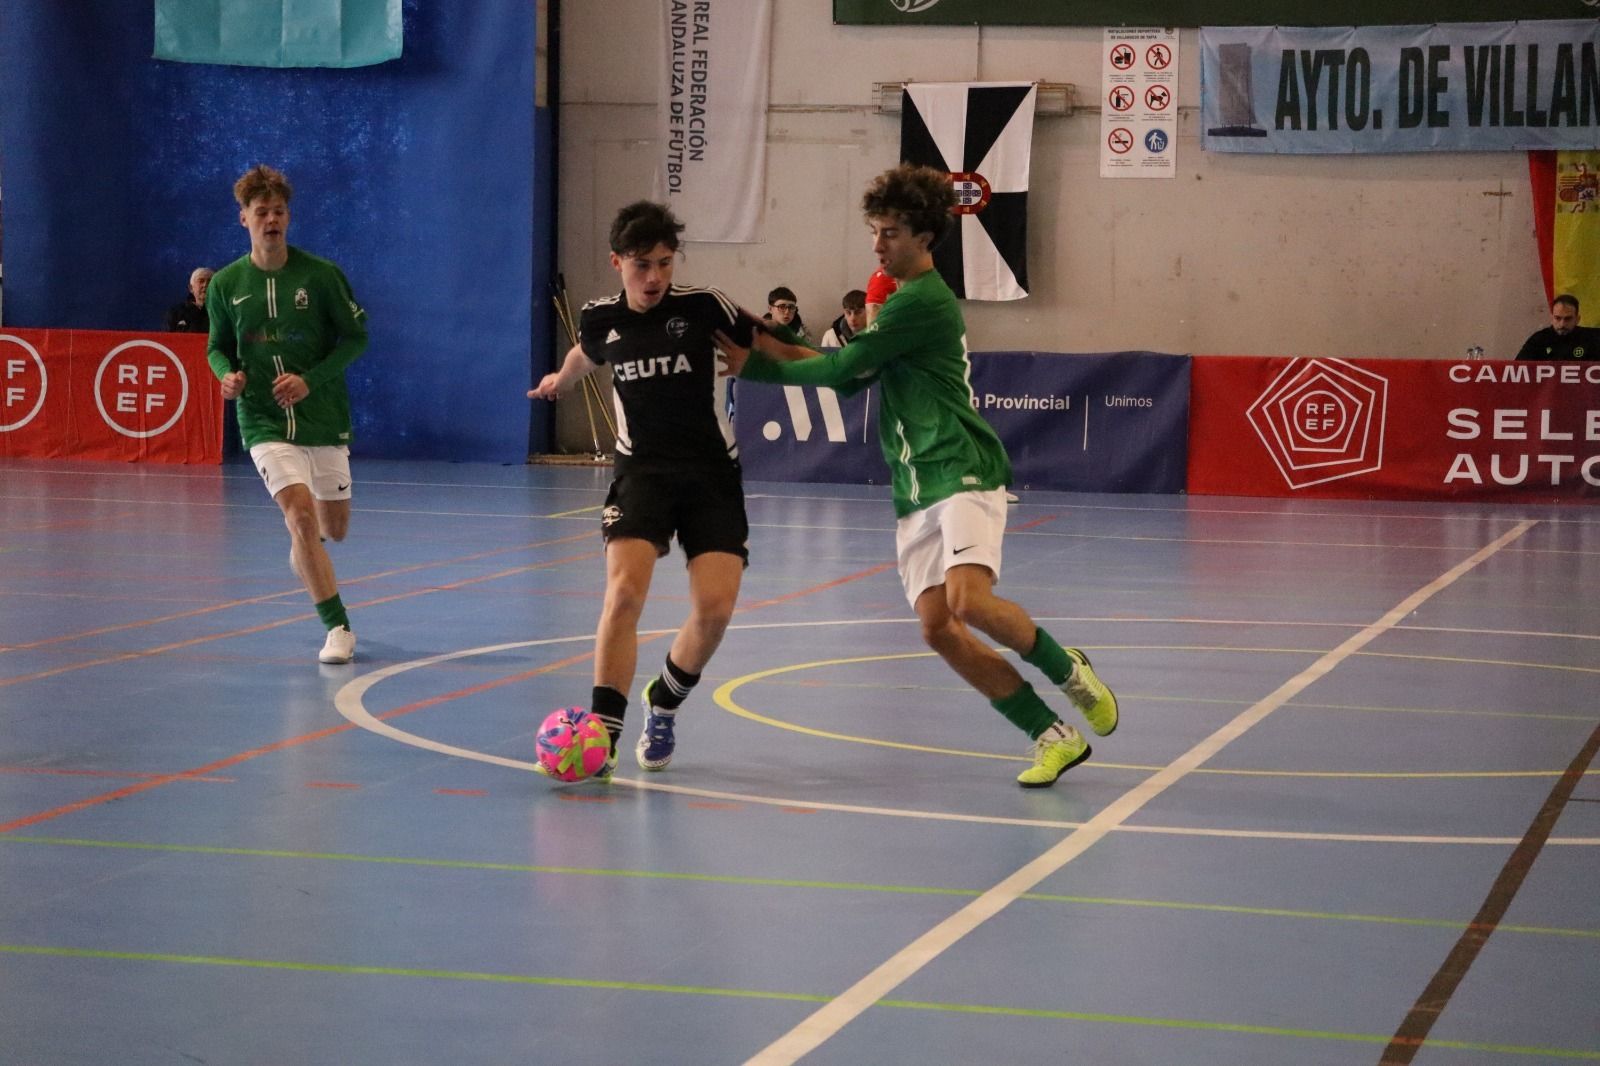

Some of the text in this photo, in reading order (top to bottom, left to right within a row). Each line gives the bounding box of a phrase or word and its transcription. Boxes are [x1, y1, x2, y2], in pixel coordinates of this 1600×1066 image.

[668, 0, 687, 196] ANDALUZA DE FÚTBOL
[689, 1, 710, 161] REAL FEDERACIÓN
[1275, 42, 1600, 131] AYTO. DE VILLAN
[614, 354, 692, 381] CEUTA
[984, 394, 1070, 410] Provincial
[1105, 395, 1153, 407] Unimos
